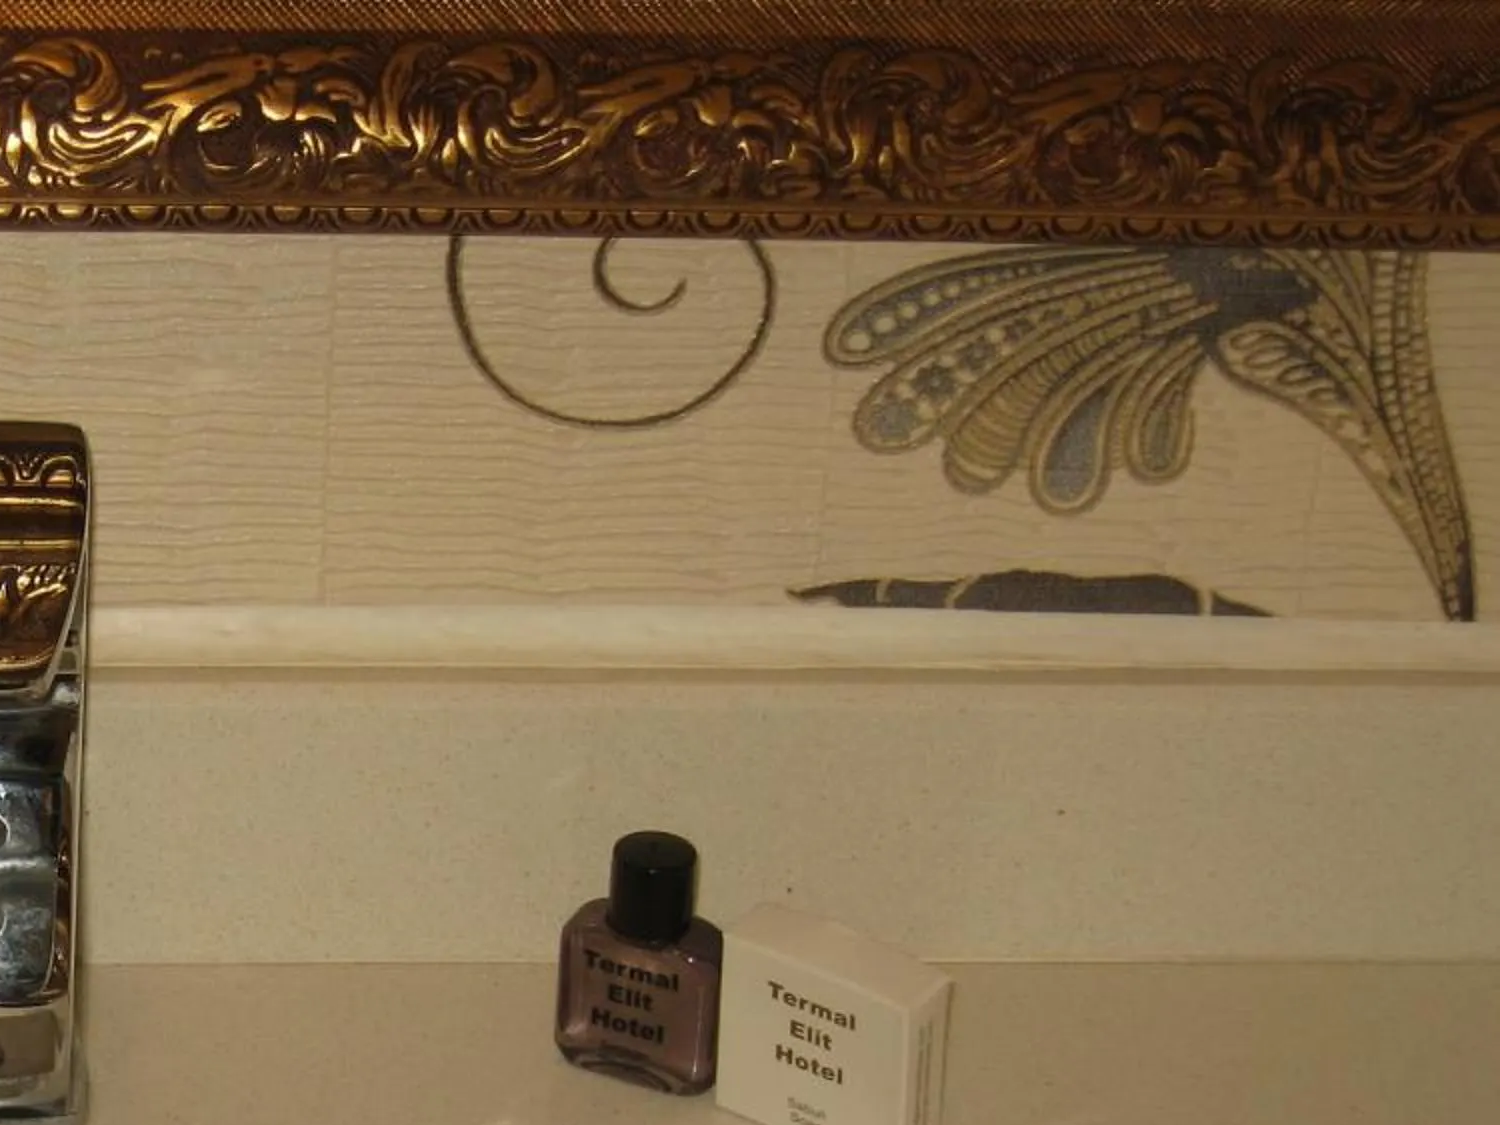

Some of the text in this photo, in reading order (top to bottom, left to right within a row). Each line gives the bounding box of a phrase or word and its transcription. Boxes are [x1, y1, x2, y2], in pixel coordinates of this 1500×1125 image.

[585, 949, 680, 992] Termal
[607, 986, 653, 1012] Elit
[768, 979, 857, 1031] Termal
[591, 1006, 666, 1046] Hotel
[789, 1019, 833, 1052] Elit
[775, 1043, 844, 1086] Hotel
